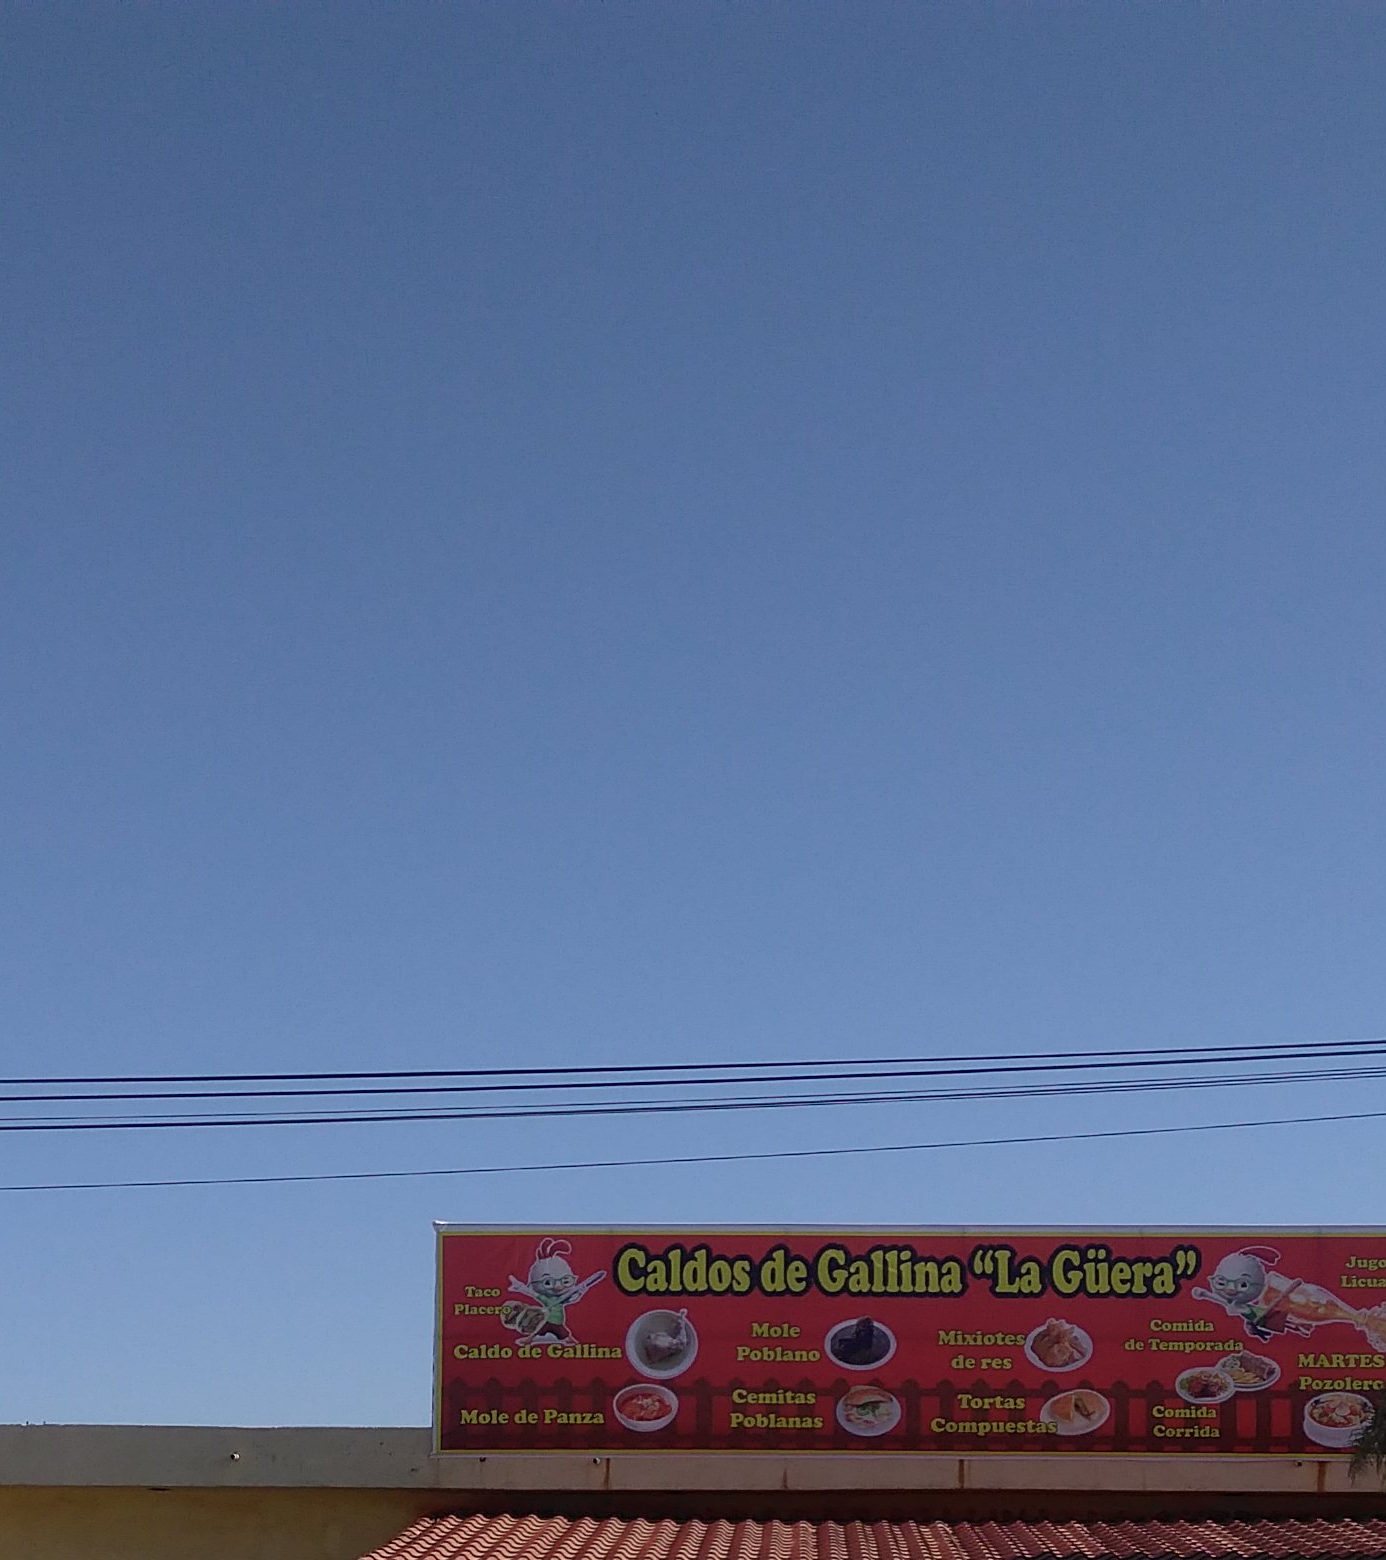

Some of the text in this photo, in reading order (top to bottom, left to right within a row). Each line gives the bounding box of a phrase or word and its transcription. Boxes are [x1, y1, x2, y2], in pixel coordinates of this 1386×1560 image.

[617, 1247, 750, 1295] Caldos
[760, 1247, 809, 1295] de
[817, 1247, 963, 1295] Gallina
[464, 1286, 501, 1299] Taco
[454, 1303, 512, 1316] Placero
[751, 1322, 801, 1338] Mole
[1149, 1319, 1215, 1333] Comida
[938, 1329, 1025, 1347] Mixiotes
[1124, 1337, 1245, 1356] de Temporada
[453, 1343, 623, 1360] Caldo de Gallina
[736, 1345, 821, 1363] Poblano
[951, 1353, 1013, 1370] de res
[1298, 1353, 1386, 1368] MARTES
[732, 1387, 816, 1406] Cemitas
[957, 1394, 1025, 1410] Tortas
[460, 1409, 605, 1426] Mole de Panza
[730, 1412, 824, 1430] Poblanas
[1152, 1405, 1218, 1420] Comida
[930, 1418, 1058, 1438] Compuestas
[1153, 1425, 1220, 1439] Corrida
